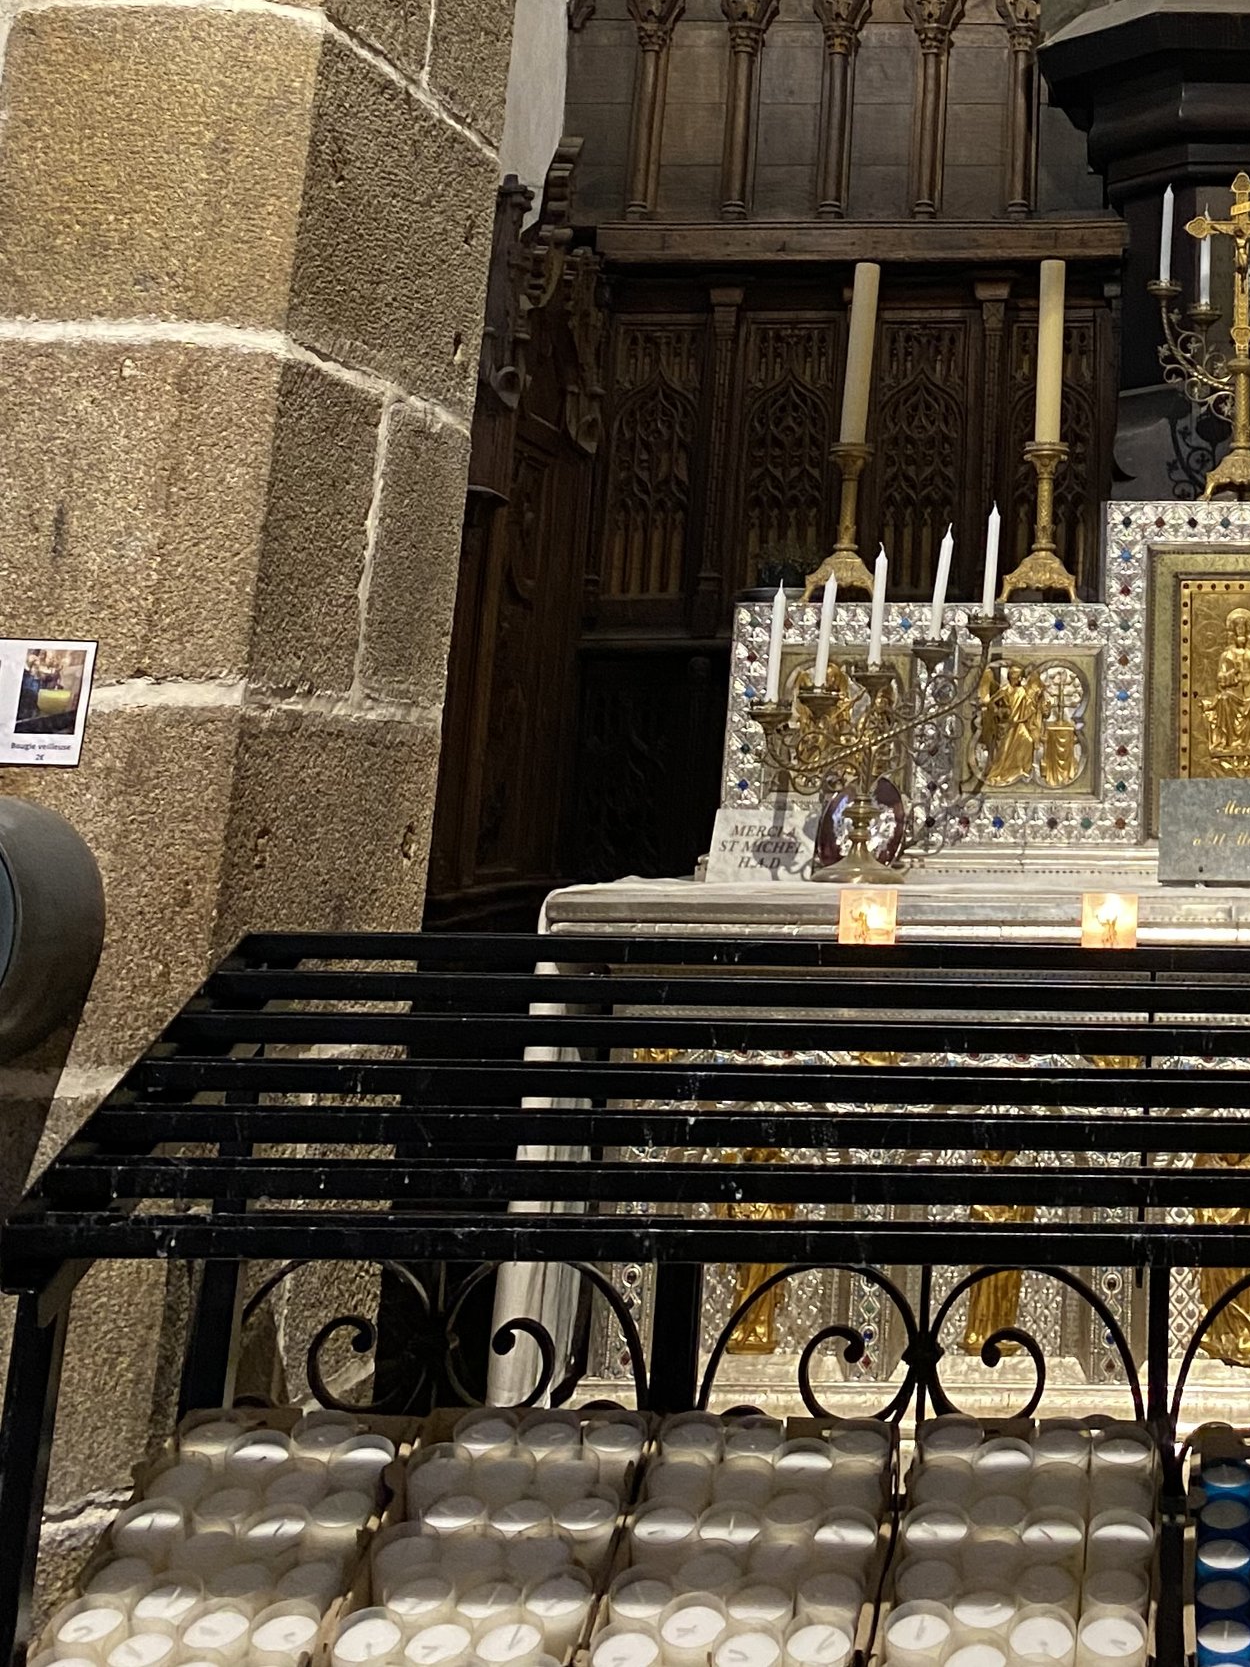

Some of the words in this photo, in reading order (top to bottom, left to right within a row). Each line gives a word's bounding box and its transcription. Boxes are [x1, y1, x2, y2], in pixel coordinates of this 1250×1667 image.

[731, 824, 784, 838] MERCI
[718, 840, 740, 853] ST
[741, 840, 805, 854] MICHEL
